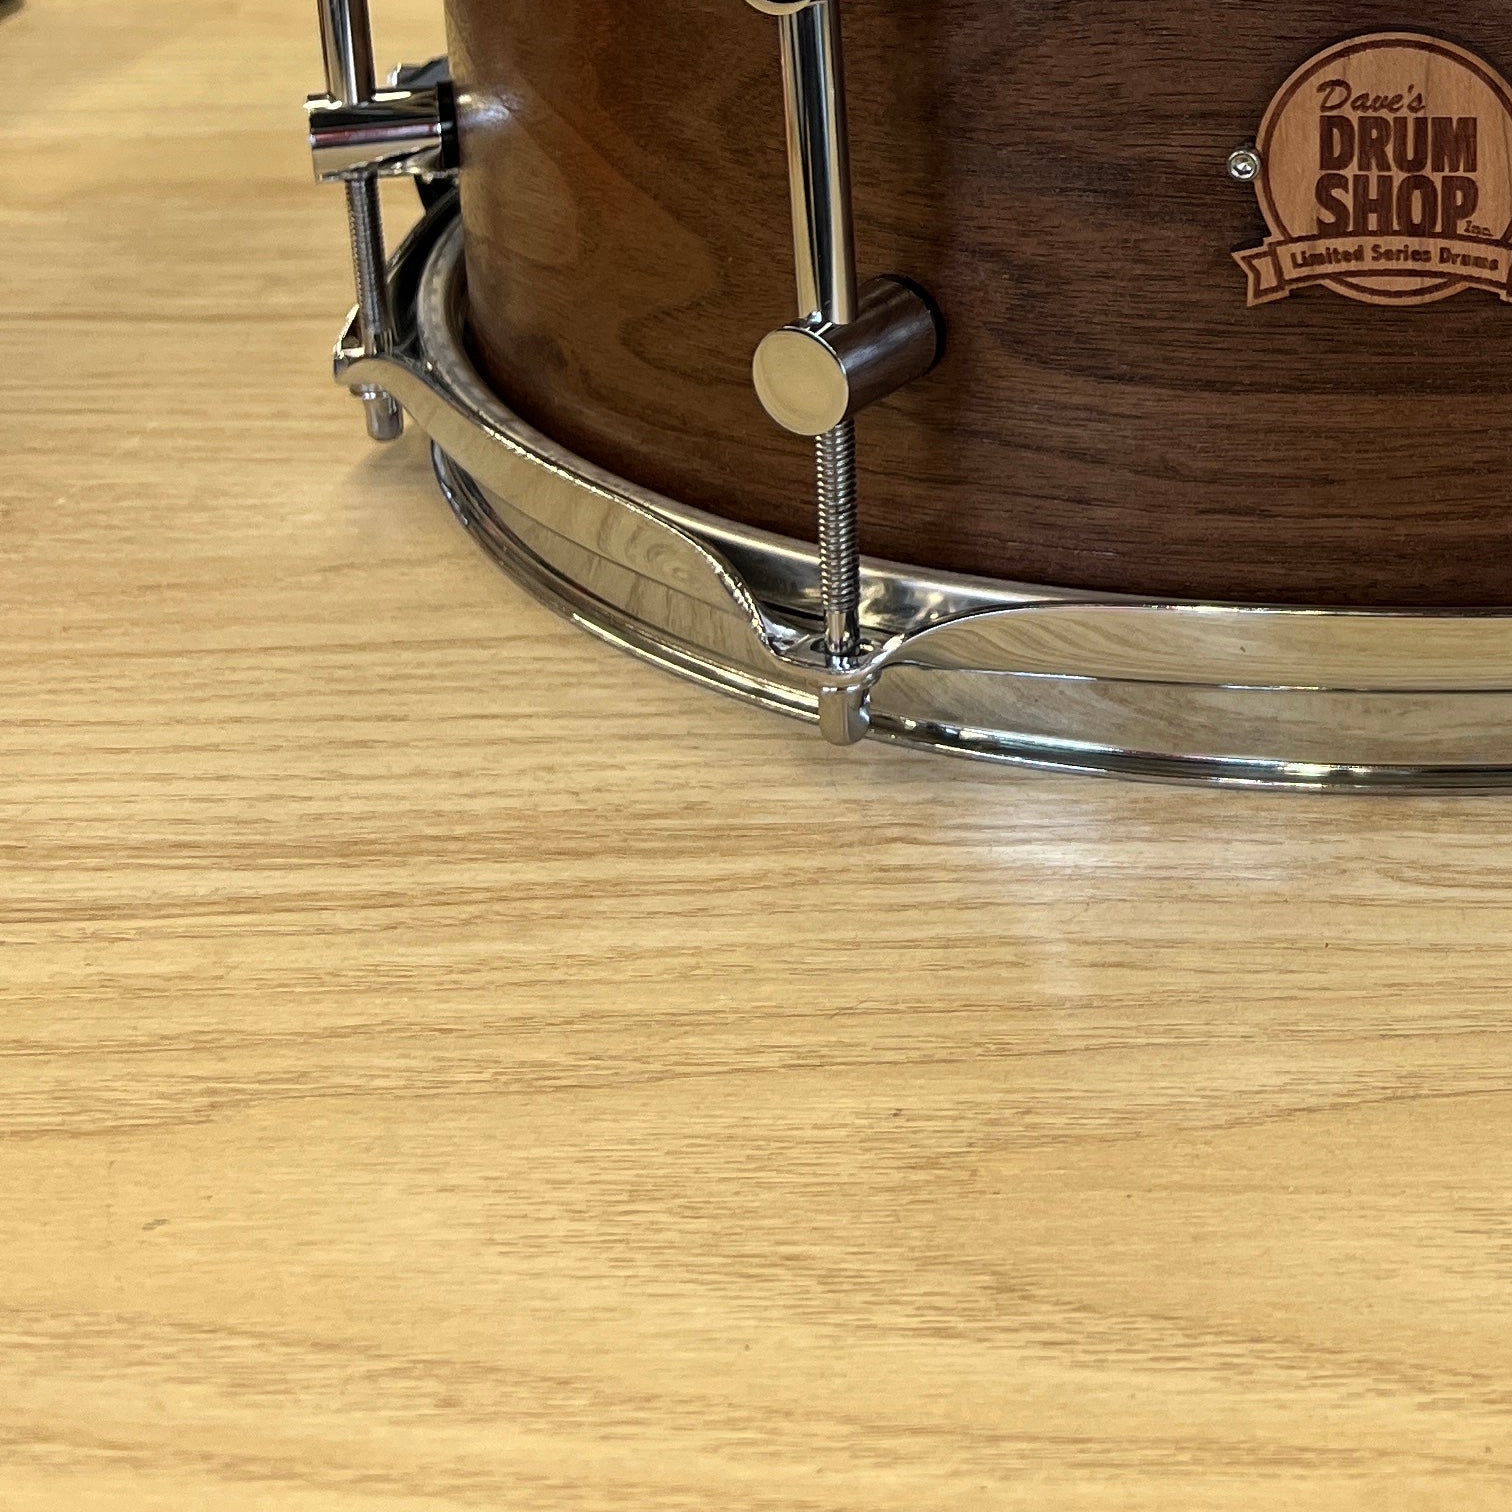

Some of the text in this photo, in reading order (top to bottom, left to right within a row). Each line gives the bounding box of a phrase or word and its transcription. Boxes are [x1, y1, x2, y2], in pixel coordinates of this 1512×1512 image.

[1315, 79, 1426, 114] Dave's
[1318, 114, 1478, 174] DRUM
[1314, 172, 1479, 237] SHOP
[1289, 244, 1499, 272] Limited Series Drums
